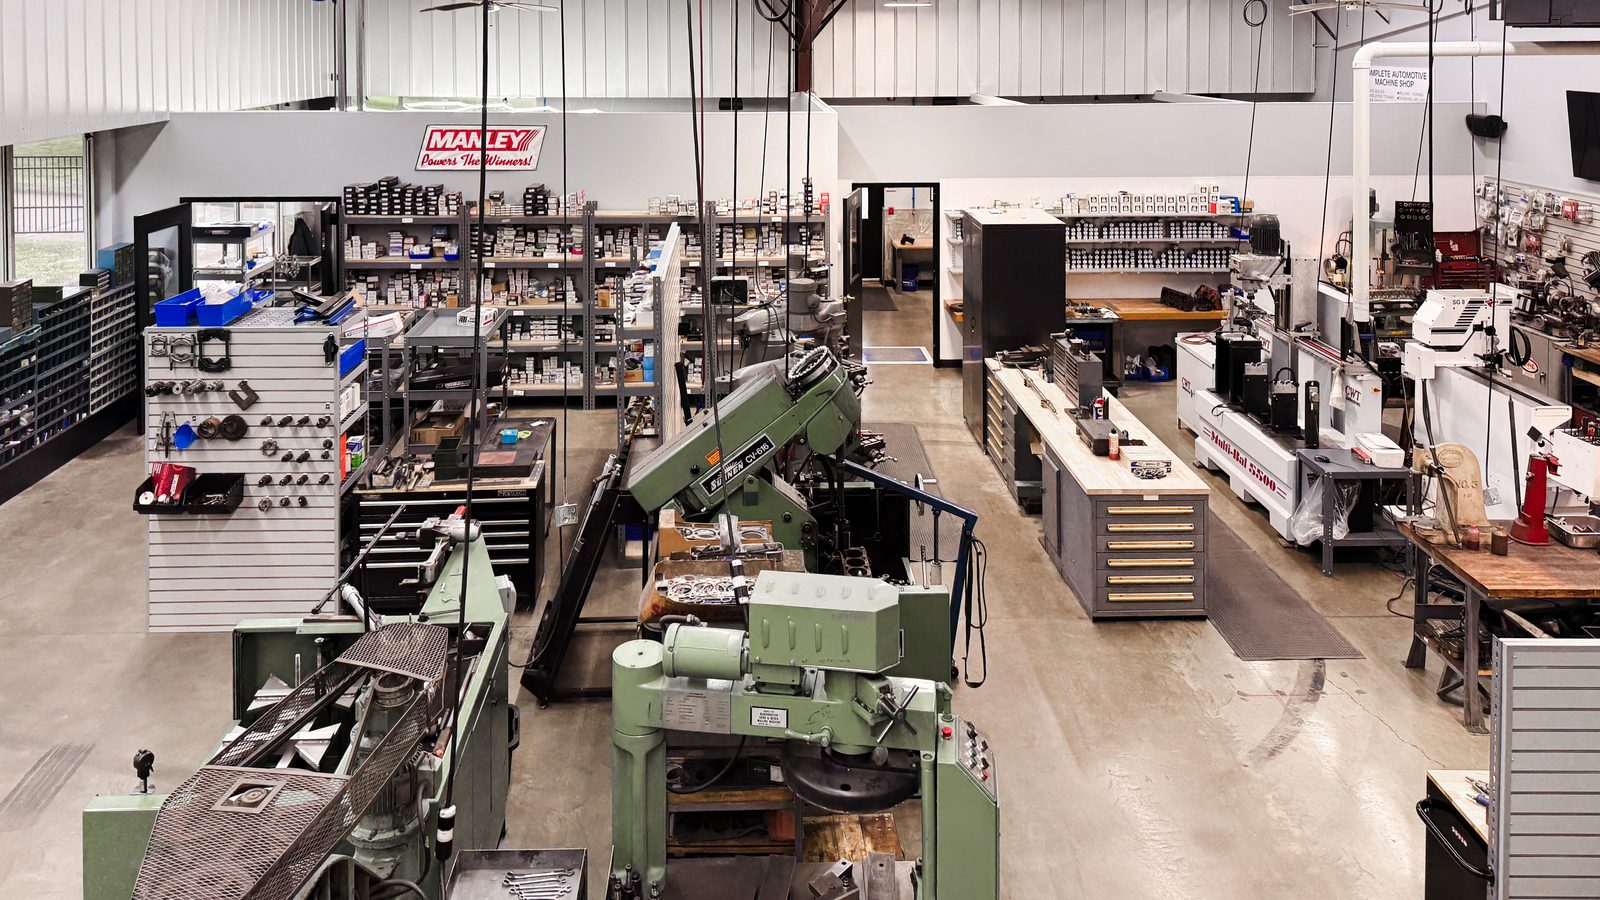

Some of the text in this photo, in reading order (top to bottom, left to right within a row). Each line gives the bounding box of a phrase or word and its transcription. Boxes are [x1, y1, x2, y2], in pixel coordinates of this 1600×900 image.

[1374, 78, 1415, 88] MACHINE SHOP
[1391, 70, 1427, 80] AUTOMOTIVE
[428, 131, 528, 149] MANLEY
[421, 153, 533, 167] Powers The Winners!
[1345, 385, 1362, 401] CWT
[710, 459, 745, 492] SUNEN
[745, 442, 770, 464] CV-616
[1210, 430, 1277, 492] Multi-Bal 5500
